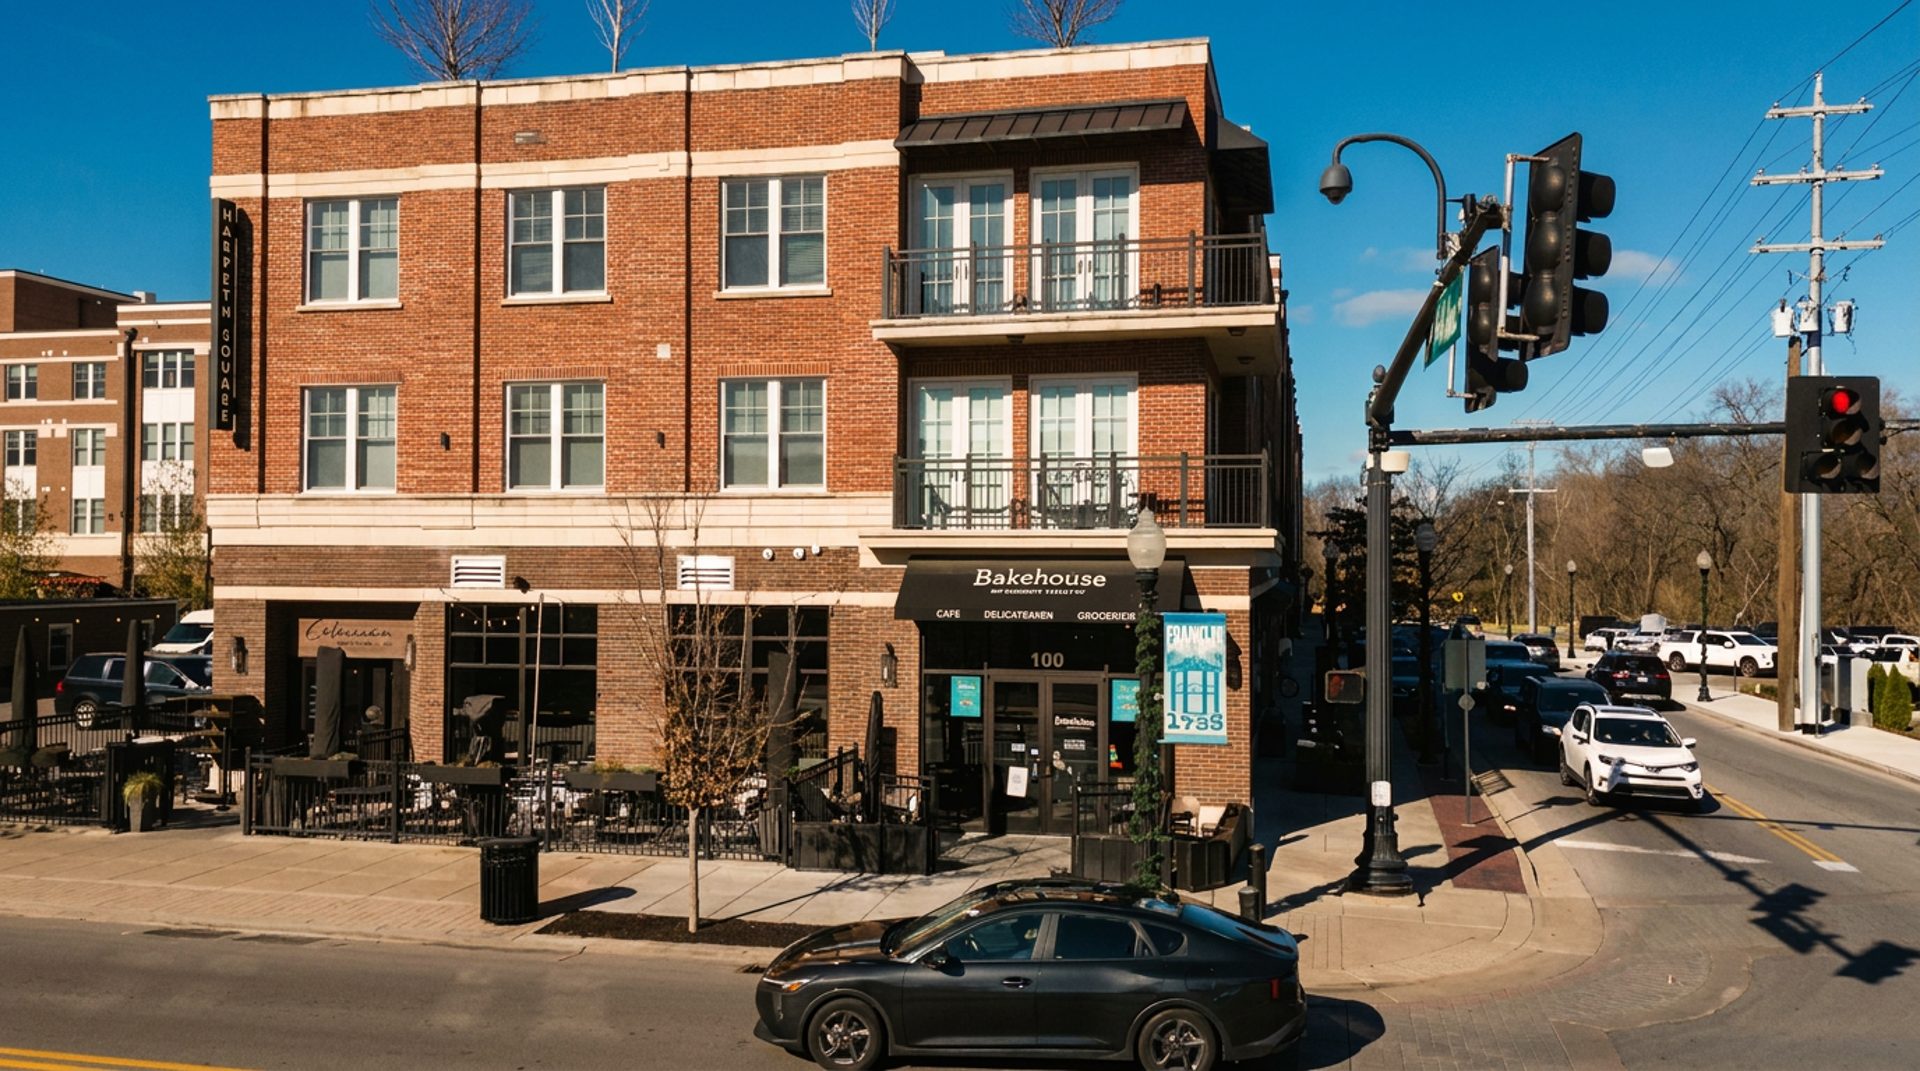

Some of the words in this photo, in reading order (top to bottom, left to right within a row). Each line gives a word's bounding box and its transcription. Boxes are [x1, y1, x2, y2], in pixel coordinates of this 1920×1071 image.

[973, 568, 1107, 587] Bakehouse
[936, 609, 960, 619] CAFE
[1031, 652, 1064, 668] 100
